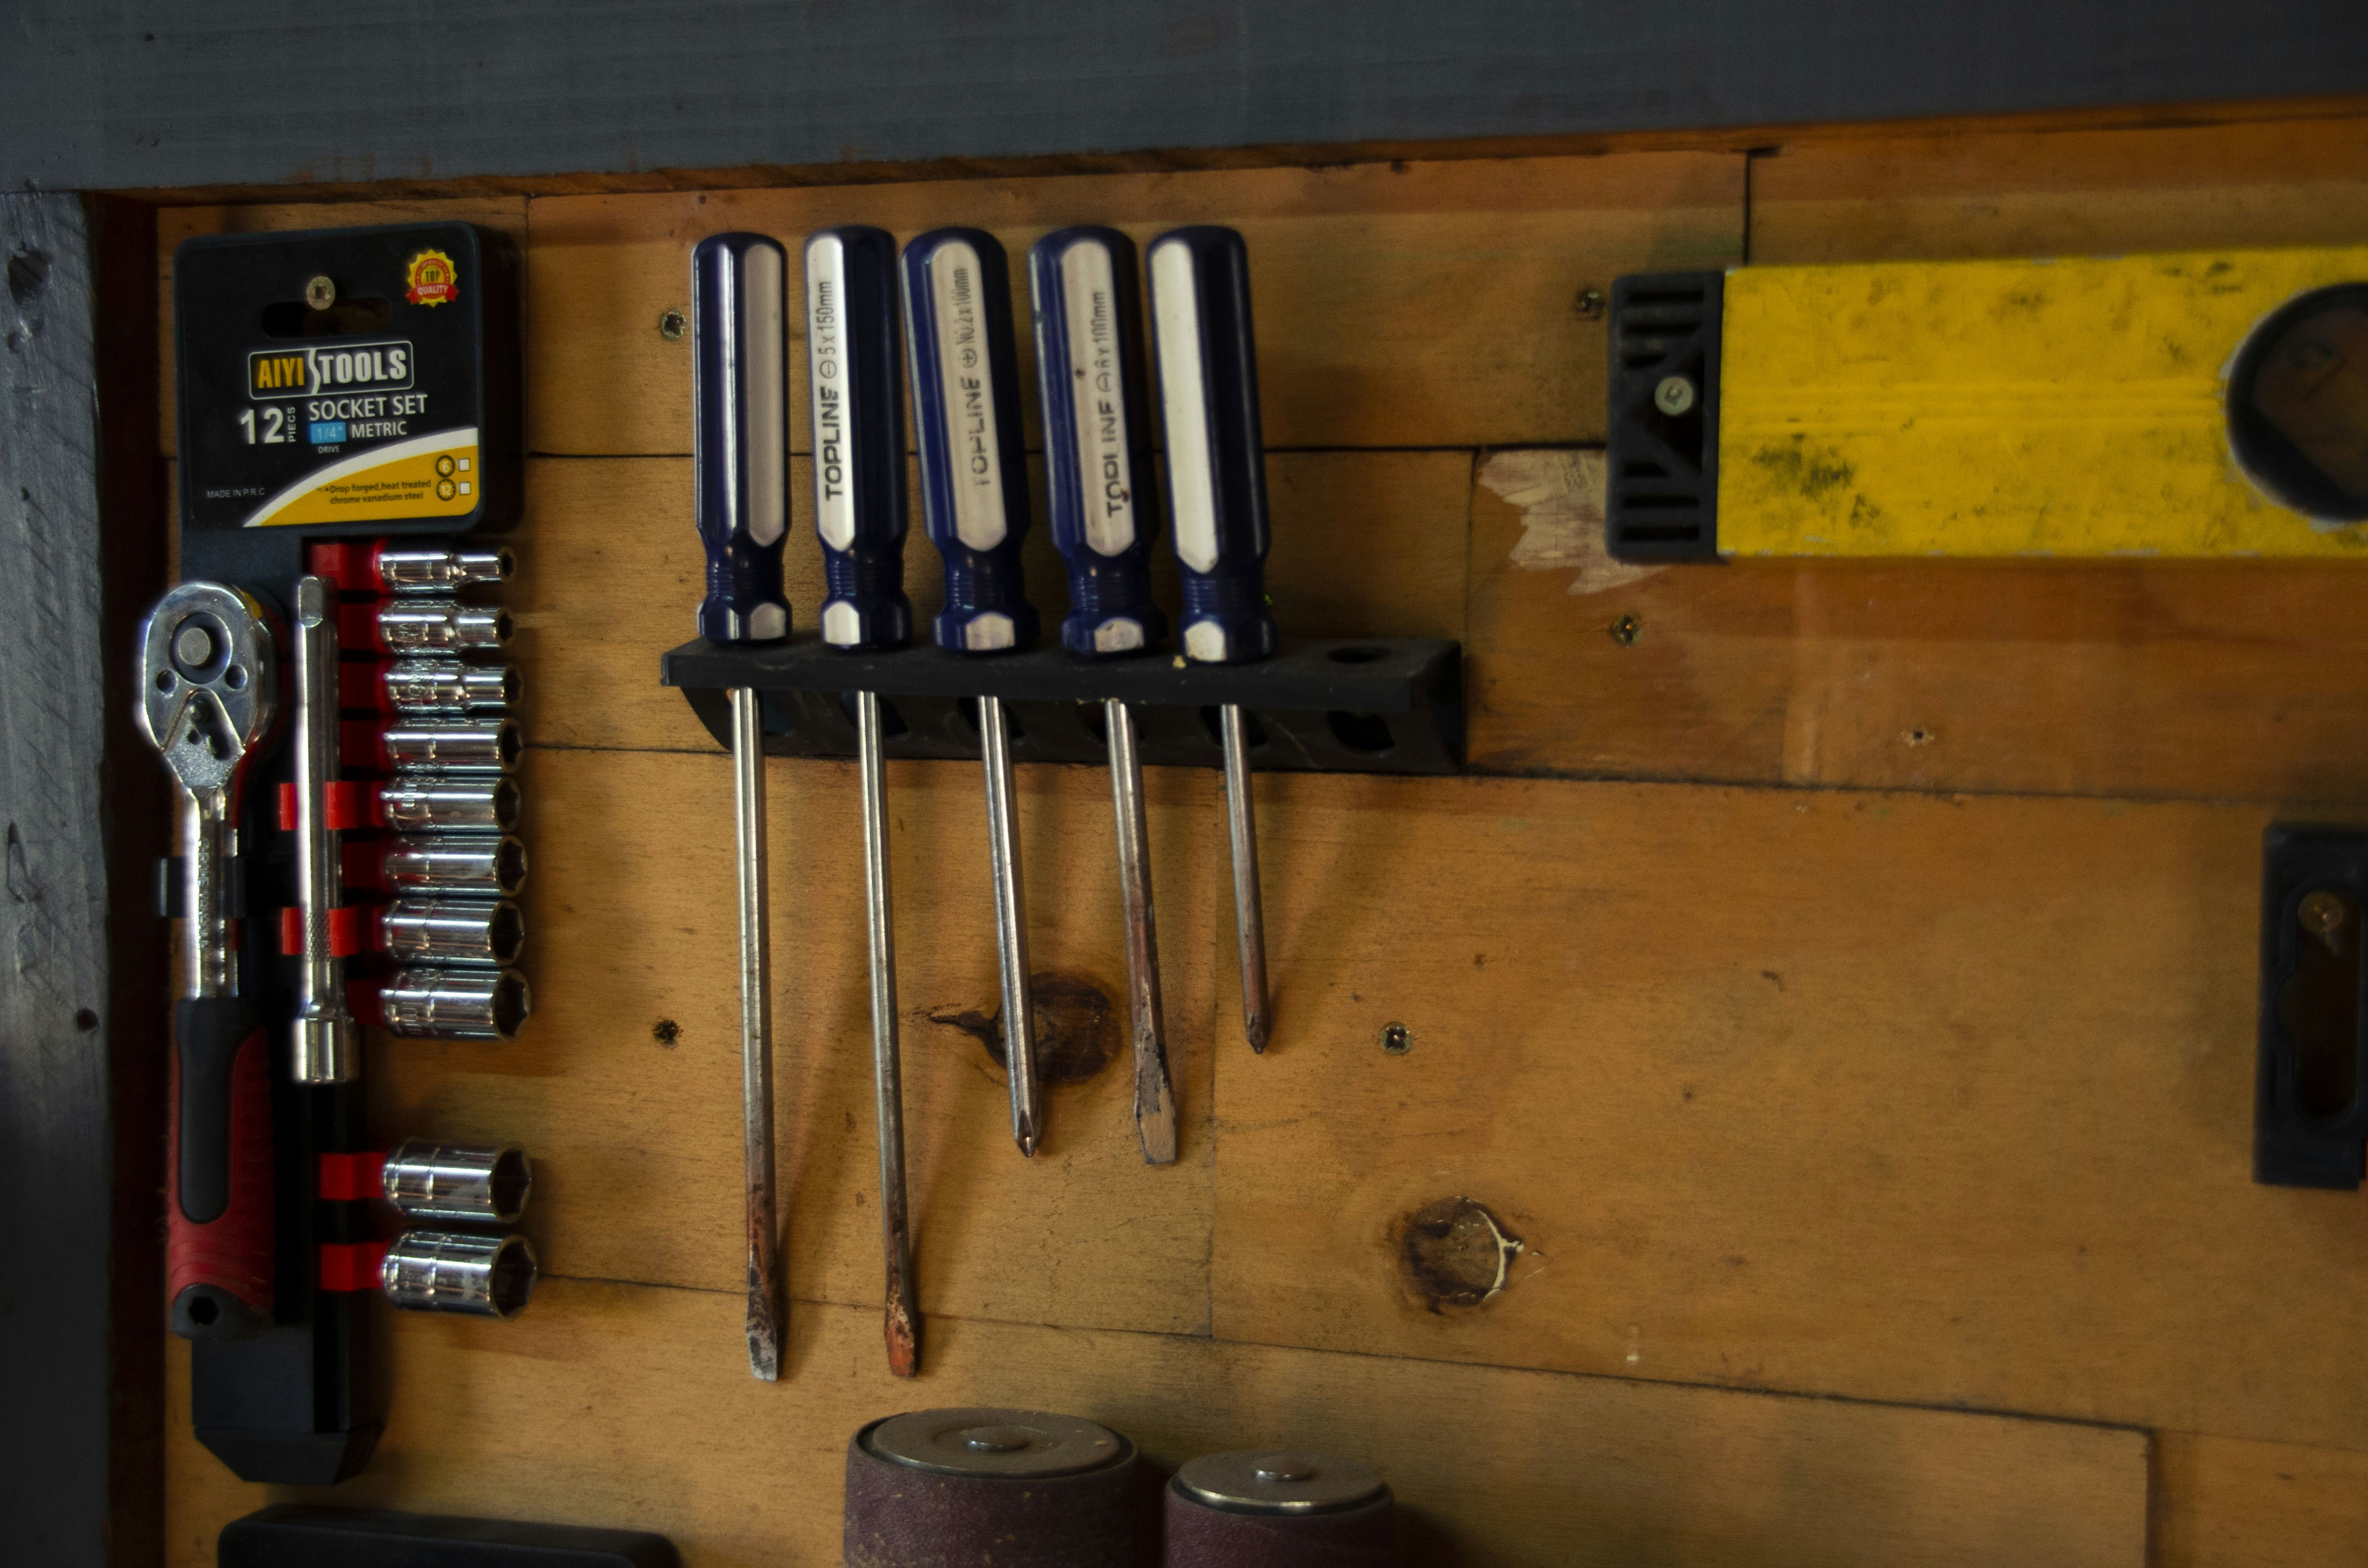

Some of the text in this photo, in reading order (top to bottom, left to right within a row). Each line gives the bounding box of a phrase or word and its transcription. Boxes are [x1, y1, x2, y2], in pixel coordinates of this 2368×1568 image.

[425, 270, 440, 282] TOP
[418, 285, 447, 295] QUALITY
[816, 281, 835, 331] 150mm
[818, 346, 837, 355] 5
[257, 349, 407, 389] AIYI TOOLS
[309, 393, 429, 421] SOCKET SET
[240, 407, 285, 445] 12
[288, 406, 296, 443] PIECS
[351, 420, 407, 439] METRIC
[318, 445, 341, 454] DRIVE
[820, 386, 843, 501] TOPLINE
[207, 489, 231, 499] MADE
[233, 488, 242, 497] IN
[330, 485, 350, 493] Drop
[401, 479, 432, 489] treated
[330, 491, 424, 504] chrome vanadium steel
